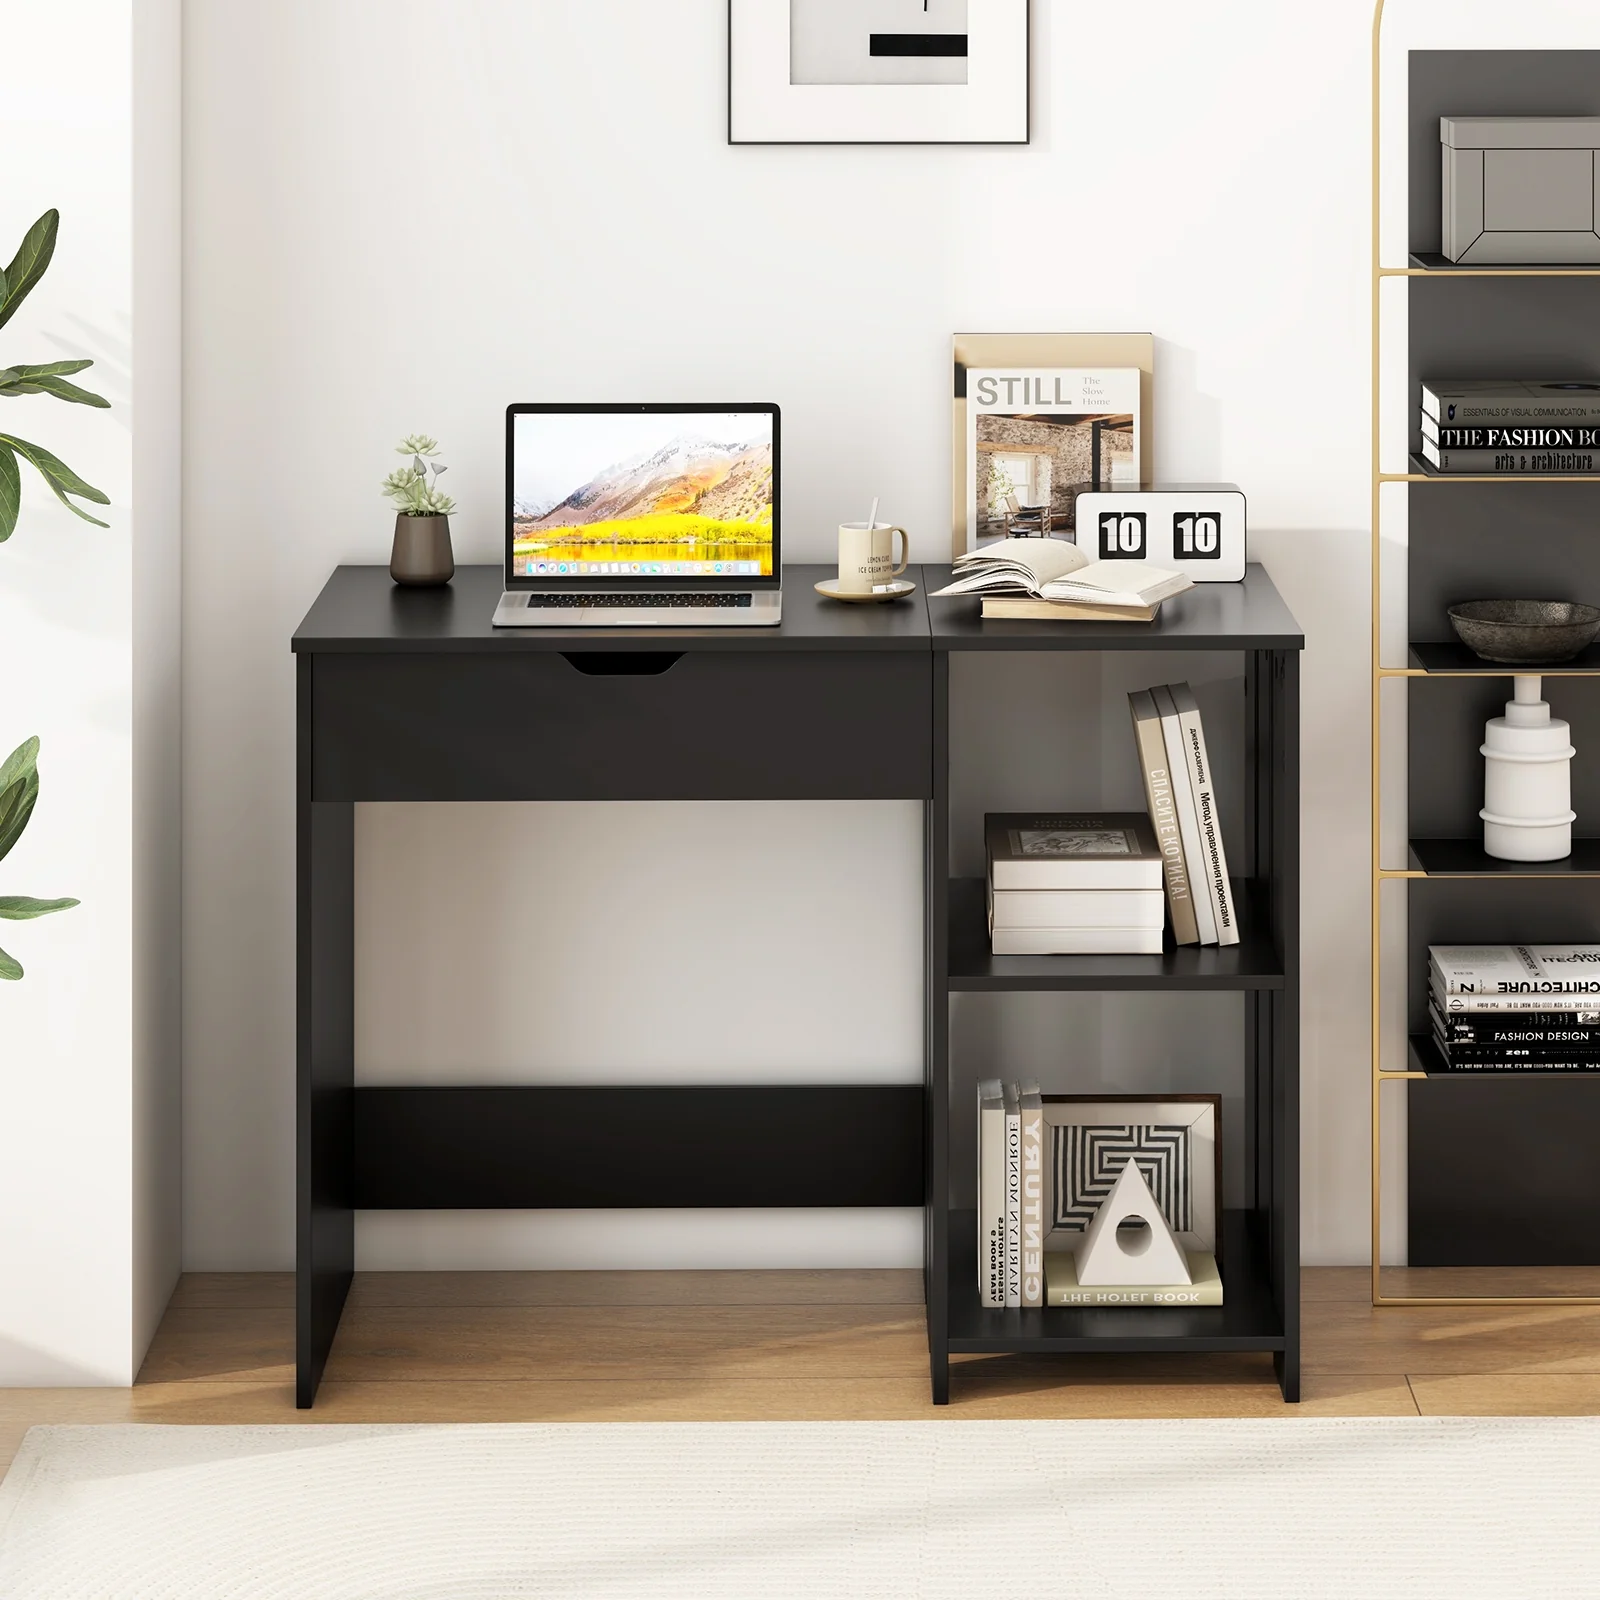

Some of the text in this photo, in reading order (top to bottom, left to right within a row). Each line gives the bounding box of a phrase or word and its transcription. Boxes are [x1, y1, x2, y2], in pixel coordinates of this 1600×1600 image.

[1082, 376, 1100, 385] The
[976, 376, 1072, 406] STILL
[1082, 387, 1104, 395] Slow
[1082, 397, 1110, 406] Home
[1463, 407, 1500, 417] ESSENTIALS
[1501, 407, 1510, 417] OF
[1511, 407, 1533, 417] VISUAL
[1534, 407, 1587, 417] COMMUNICATION
[1441, 429, 1483, 446] THE
[1486, 429, 1573, 446] FASHION
[1495, 453, 1515, 470] arts
[1532, 452, 1592, 470] architecture
[1101, 516, 1142, 552] 10
[1176, 516, 1217, 552] 10
[1151, 768, 1188, 900] СПАСИТЕ КОТИКА!
[1200, 791, 1230, 927] Метод управления проектами
[1494, 1032, 1544, 1041] FASHION
[1547, 1032, 1589, 1041] DESIGN
